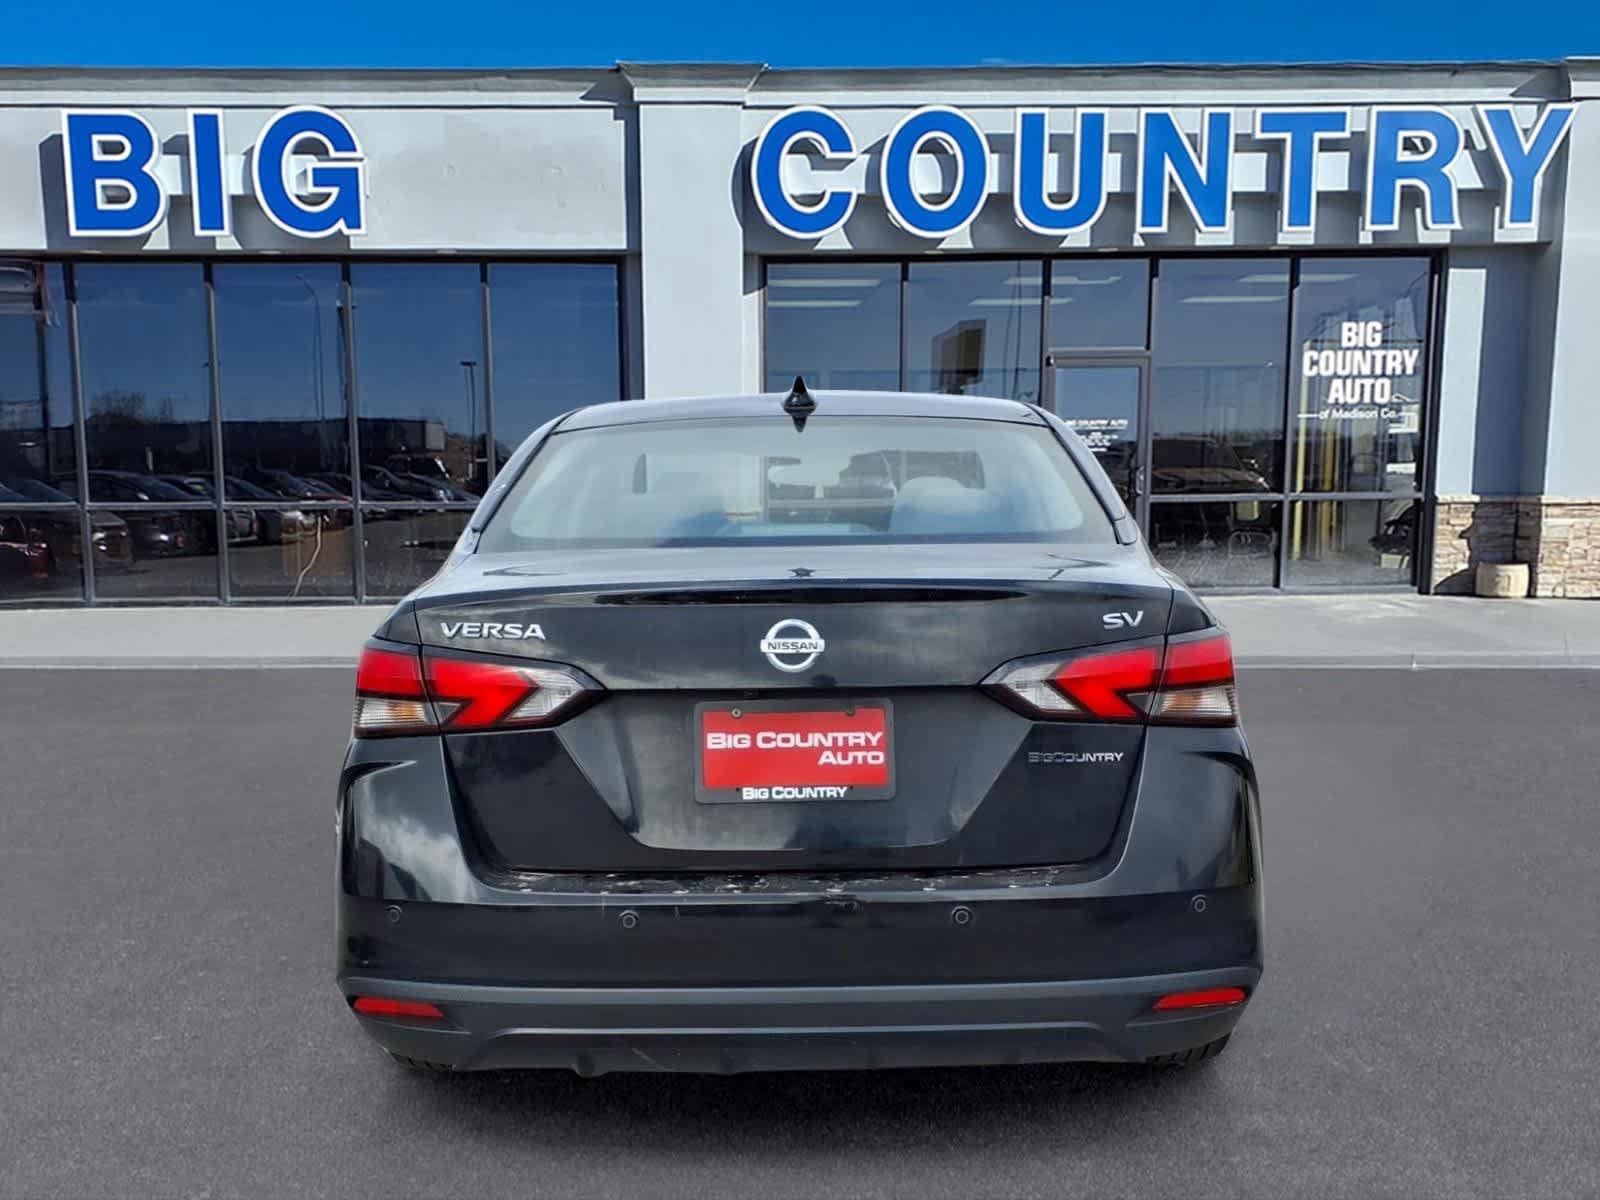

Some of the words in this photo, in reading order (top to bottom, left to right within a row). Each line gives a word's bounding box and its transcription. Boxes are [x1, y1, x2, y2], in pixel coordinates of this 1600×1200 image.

[61, 105, 367, 238] BIG
[751, 105, 1574, 241] COUNTRY
[1341, 321, 1383, 347] BIG
[1303, 349, 1419, 376] COUNTRY
[1327, 377, 1392, 404] AUTO
[1102, 610, 1144, 629] SV
[440, 622, 546, 640] VERSA
[767, 641, 818, 650] NISSAN
[706, 732, 751, 749] BIG
[756, 732, 883, 749] COUNTRY
[817, 751, 885, 765] AUTO
[742, 787, 769, 800] BIG
[771, 786, 848, 799] COUNTRY
